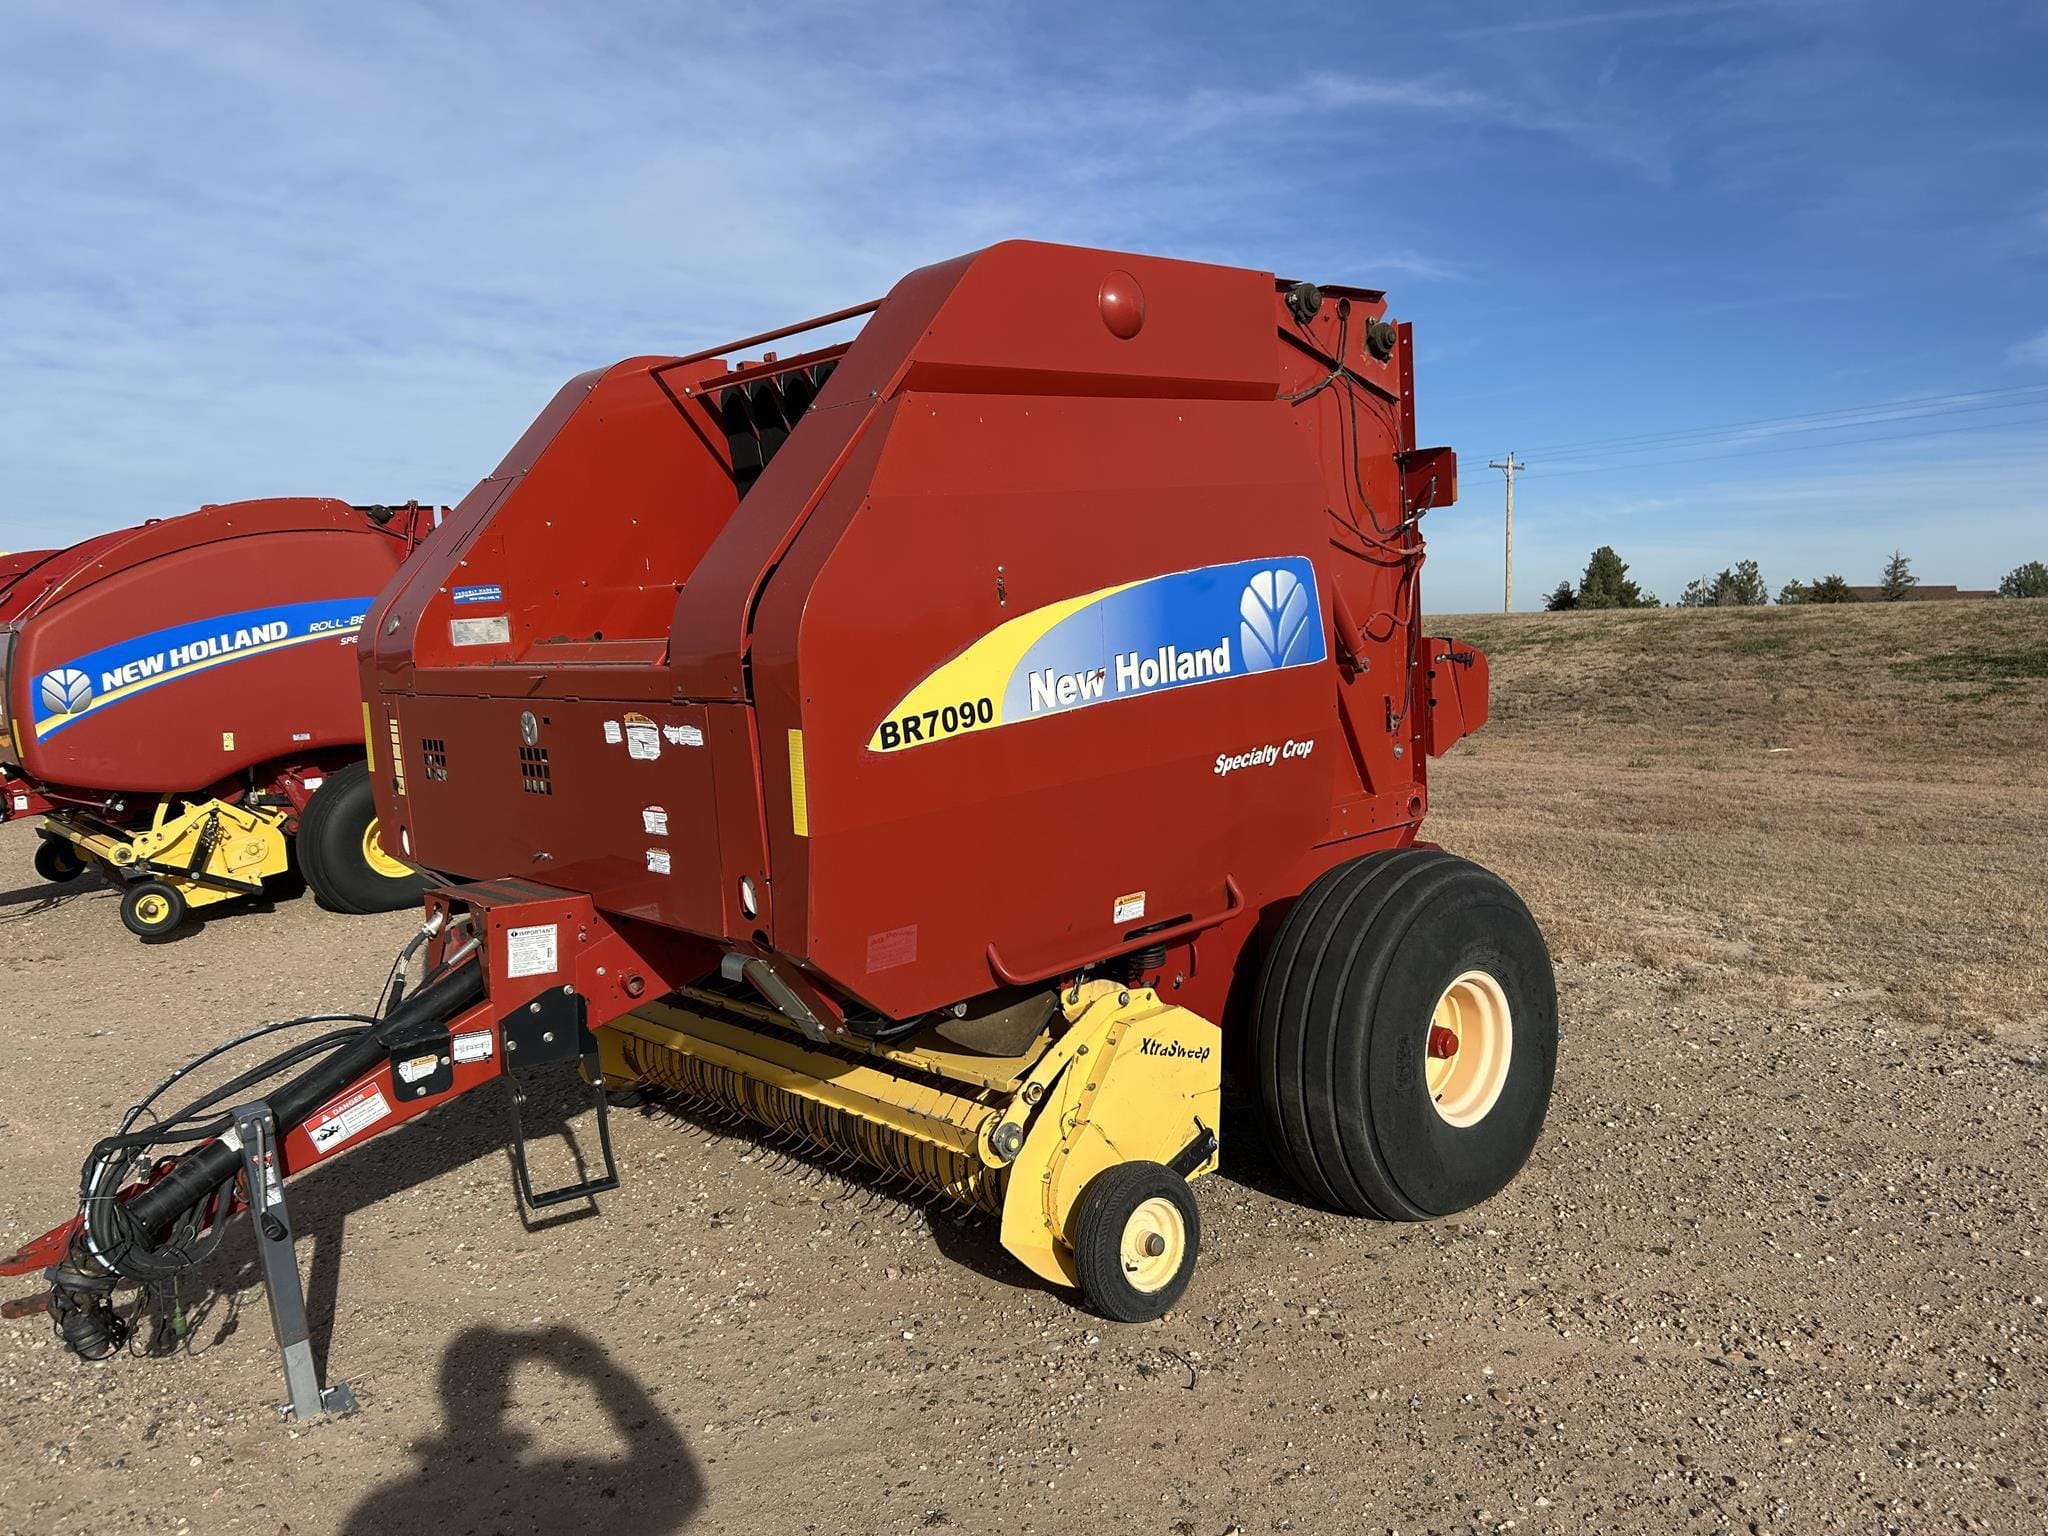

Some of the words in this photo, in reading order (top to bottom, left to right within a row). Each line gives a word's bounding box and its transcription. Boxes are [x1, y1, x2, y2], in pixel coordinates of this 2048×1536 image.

[101, 653, 165, 692] NEW
[169, 621, 288, 668] HOLLAND
[1029, 667, 1106, 712] New
[1115, 637, 1231, 692] Holland
[880, 697, 994, 750] BR7090
[1213, 744, 1281, 777] Specialty
[1282, 739, 1314, 759] Crop
[518, 927, 554, 937] IMPORTANT
[1140, 1037, 1210, 1064] XtraSweep
[332, 1093, 366, 1116] DANGER
